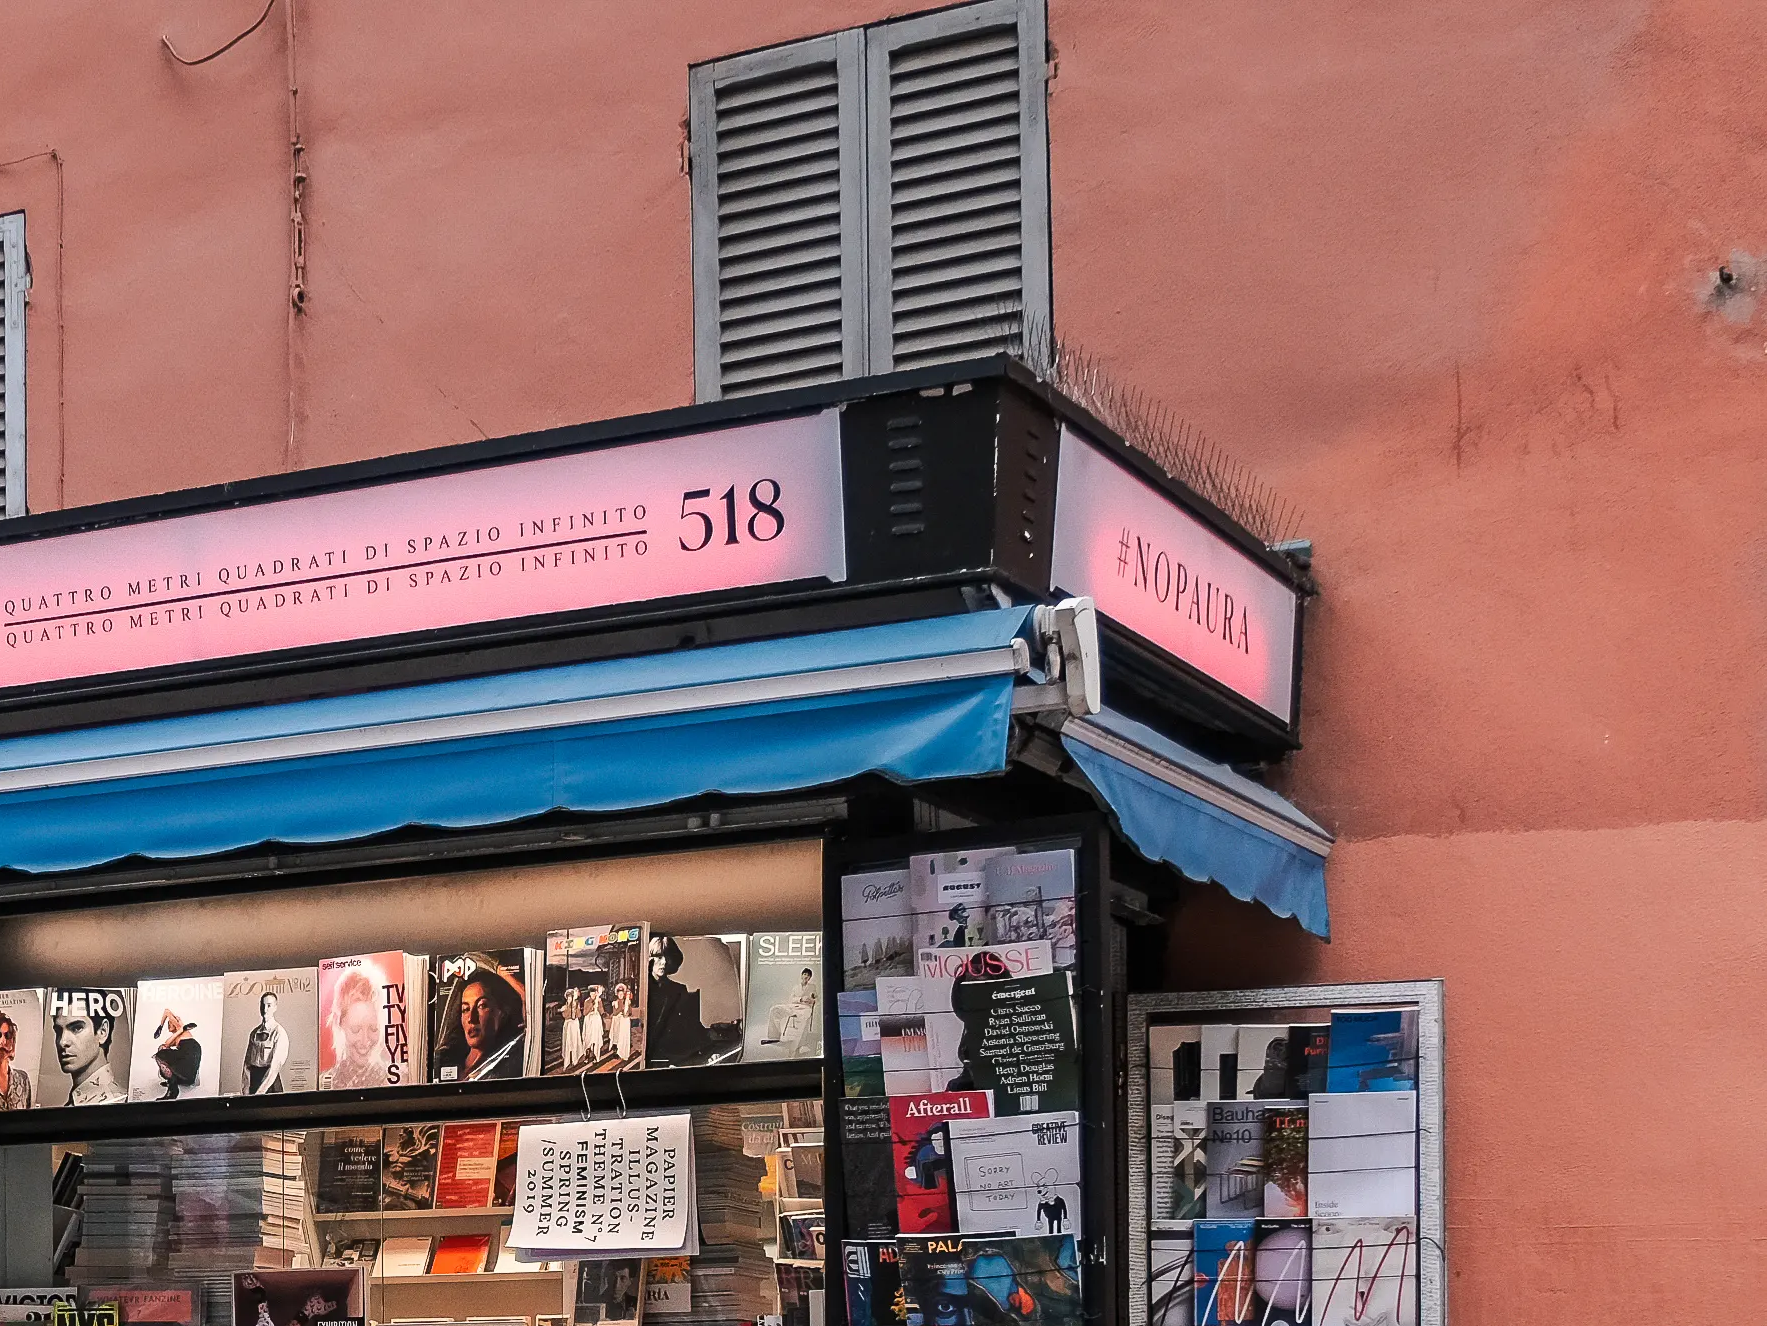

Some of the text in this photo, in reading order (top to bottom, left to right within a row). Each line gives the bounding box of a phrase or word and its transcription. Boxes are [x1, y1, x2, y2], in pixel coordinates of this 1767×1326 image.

[678, 478, 786, 552] 518
[4, 505, 647, 616] QUATTRO METRI QUADRATI DI SPAZIO INFINITO
[5, 540, 649, 649] QUATTRO METRI QUADRATI DI SPAZIO INFINITO
[1117, 526, 1249, 655] #NOPAURA
[923, 947, 1042, 979] MOUSSE
[50, 991, 124, 1018] HERO
[984, 1026, 1009, 1037] David
[387, 1064, 401, 1085] S
[905, 1097, 973, 1118] Afterall
[592, 1128, 608, 1206] THEME
[978, 1165, 1011, 1178] SORRY
[1037, 1132, 1068, 1146] REVIEW
[522, 1169, 537, 1214] 2019
[555, 1150, 572, 1228] SPRING
[571, 1140, 589, 1235] FEMINISM
[607, 1138, 624, 1235] TRATION
[640, 1126, 660, 1242] MAGAZINE
[661, 1147, 677, 1222] PAPIER
[985, 1192, 1016, 1203] TODAY
